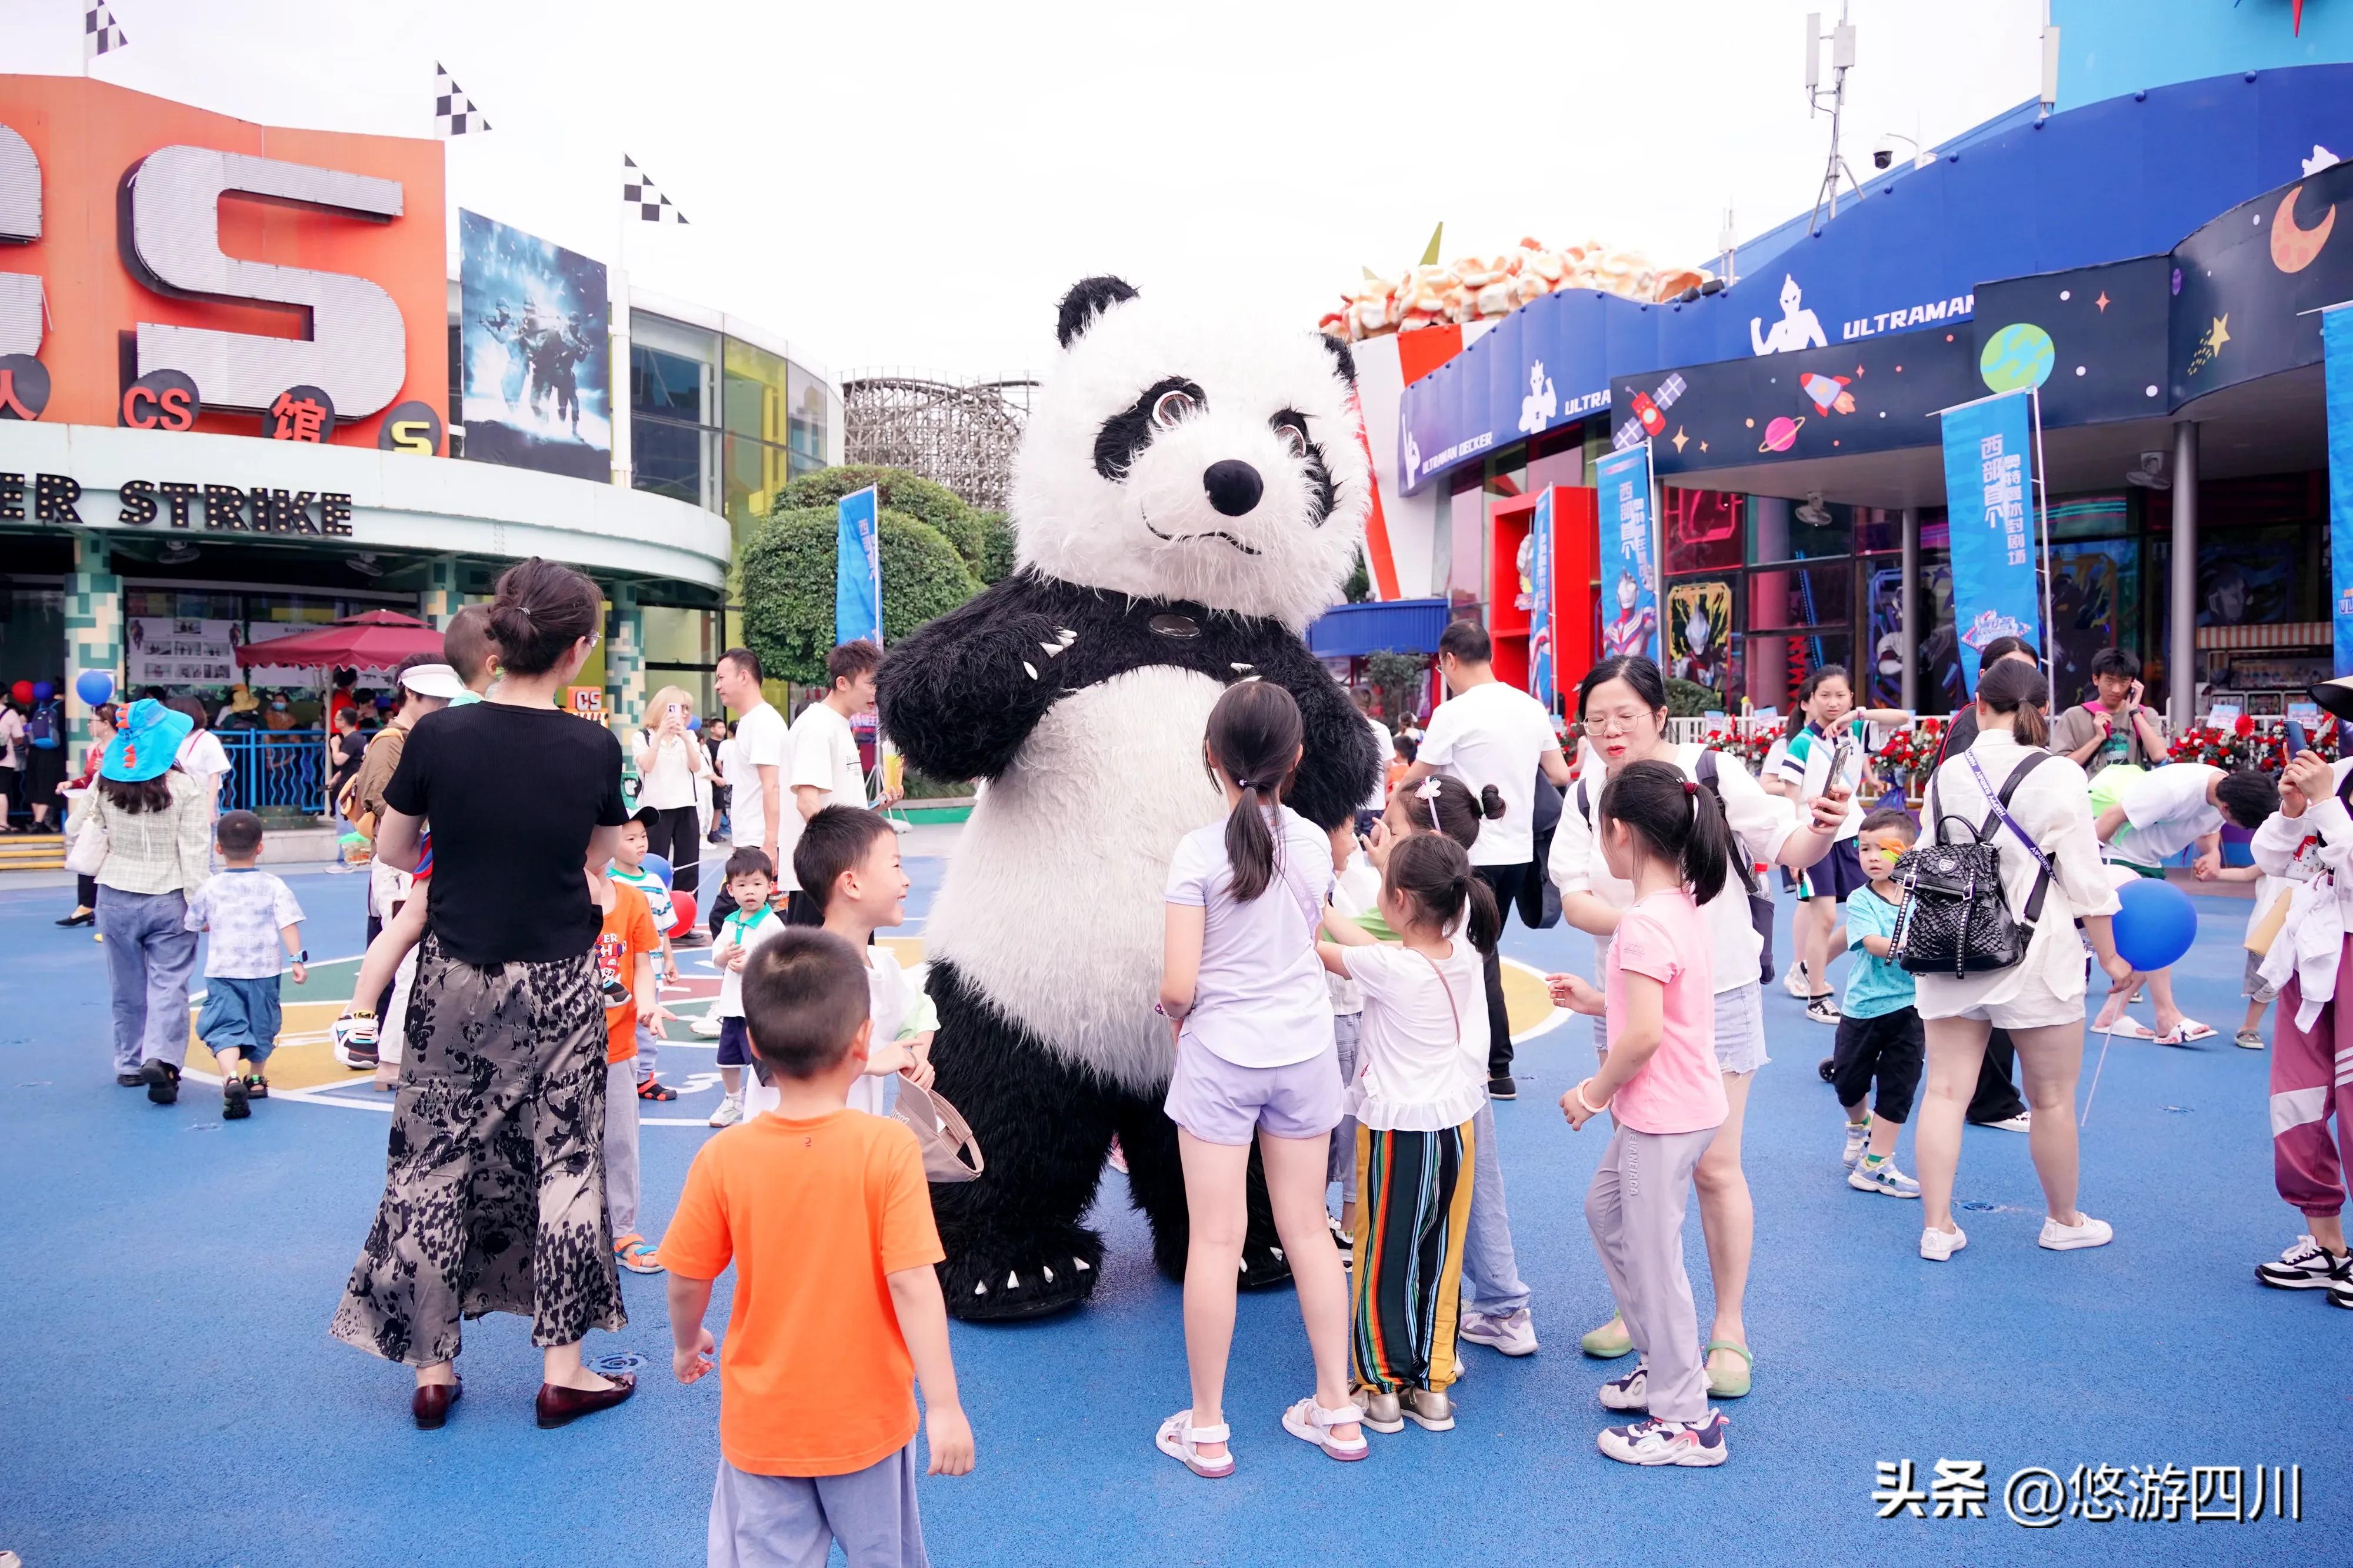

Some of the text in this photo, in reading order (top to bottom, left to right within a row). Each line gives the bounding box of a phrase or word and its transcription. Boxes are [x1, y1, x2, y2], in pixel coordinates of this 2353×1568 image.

[124, 386, 193, 431] CS
[1422, 431, 1492, 475] ULTRAMAN DECKER
[1981, 433, 2005, 529] 西部首个
[119, 479, 353, 536] STRIKE
[576, 690, 601, 712] CS
[1988, 795, 2006, 817] HAPPY
